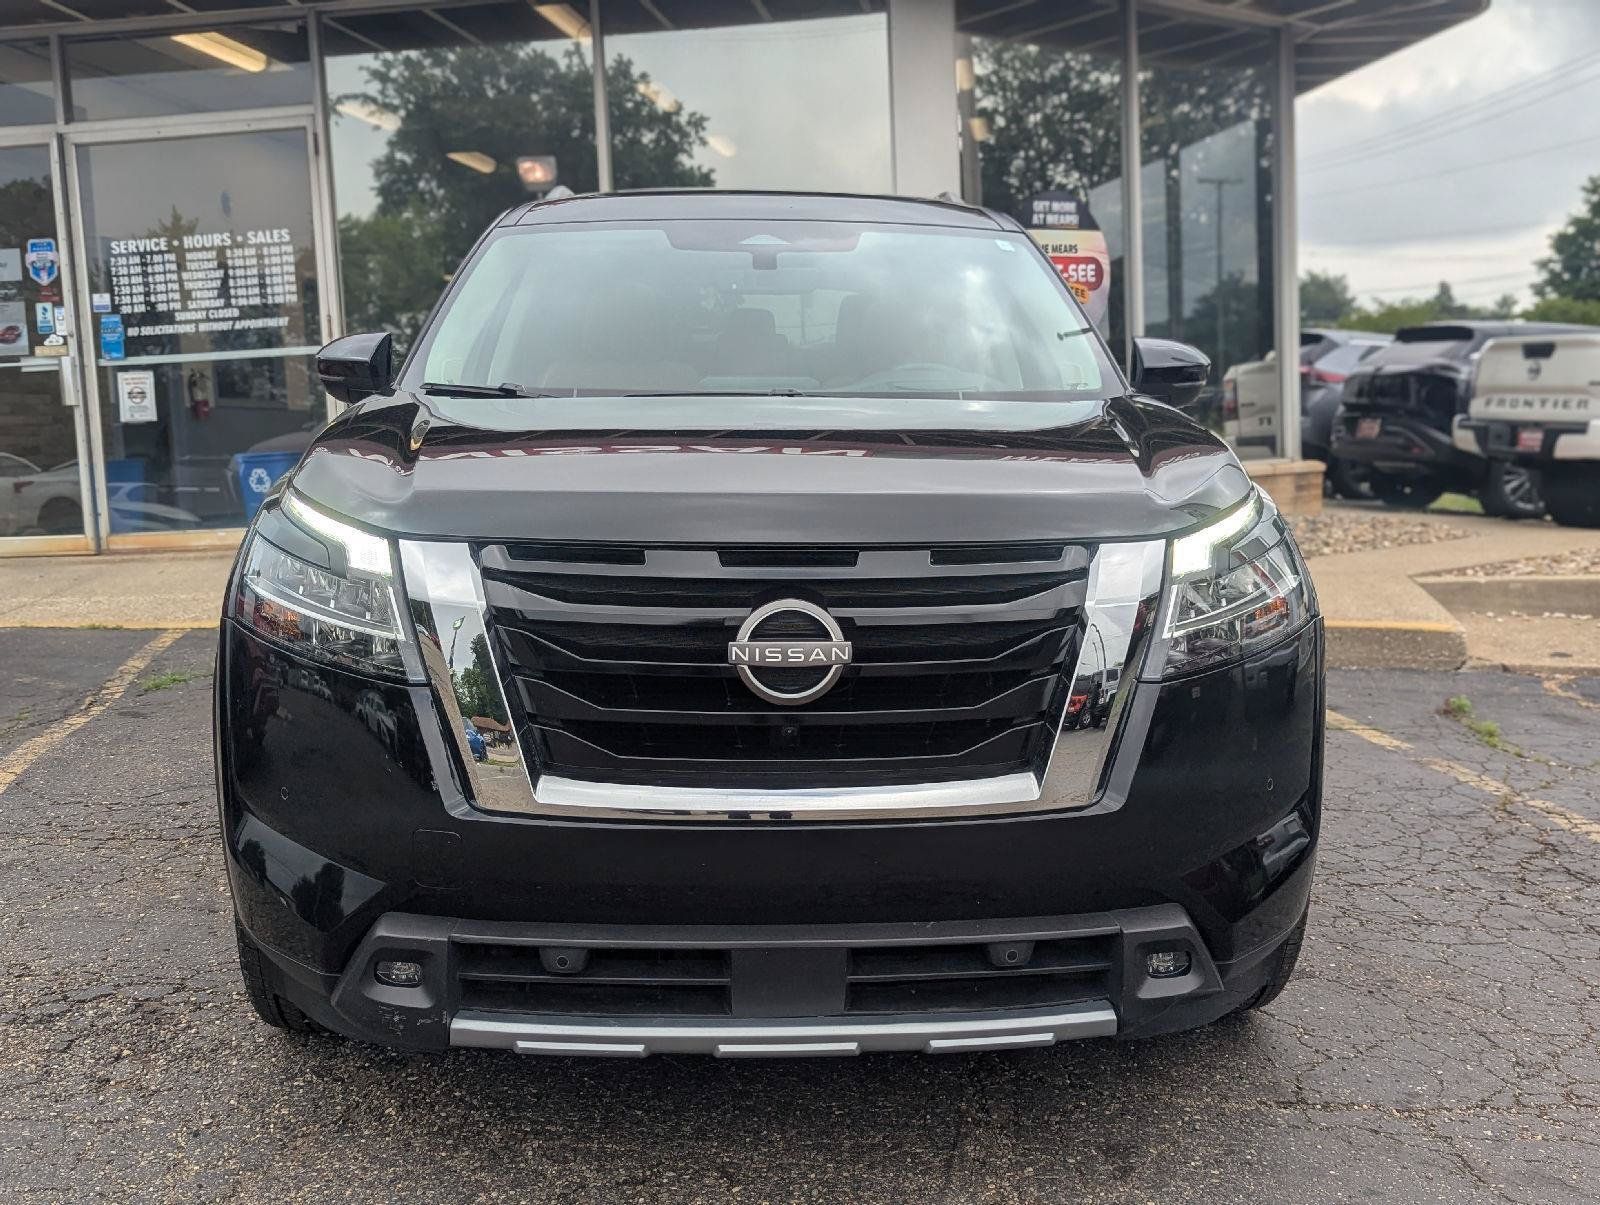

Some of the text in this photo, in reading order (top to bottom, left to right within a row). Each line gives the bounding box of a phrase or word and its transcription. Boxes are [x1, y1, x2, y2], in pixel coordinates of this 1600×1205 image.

[110, 228, 290, 254] SERVICE HOURS SALES
[129, 254, 142, 264] AM
[164, 252, 176, 262] PM
[281, 245, 293, 253] PM
[1051, 244, 1078, 254] MEARS
[130, 264, 142, 274] AM
[165, 262, 178, 272] PM
[282, 255, 294, 263] PM
[166, 272, 178, 282] PM
[283, 265, 295, 273] PM
[132, 284, 144, 293] AM
[168, 282, 180, 291] PM
[133, 294, 145, 303] AM
[168, 291, 180, 301] PM
[192, 290, 217, 299] FRIDAY
[133, 303, 146, 313] AM
[169, 301, 181, 311] PM
[187, 299, 224, 309] SATURDAY
[175, 308, 240, 321] SUNDAY CLOSED
[127, 326, 140, 337] NO
[198, 320, 233, 332] WITHOUT
[1484, 398, 1588, 410] FRONTIER
[732, 646, 848, 662] NISSAN
